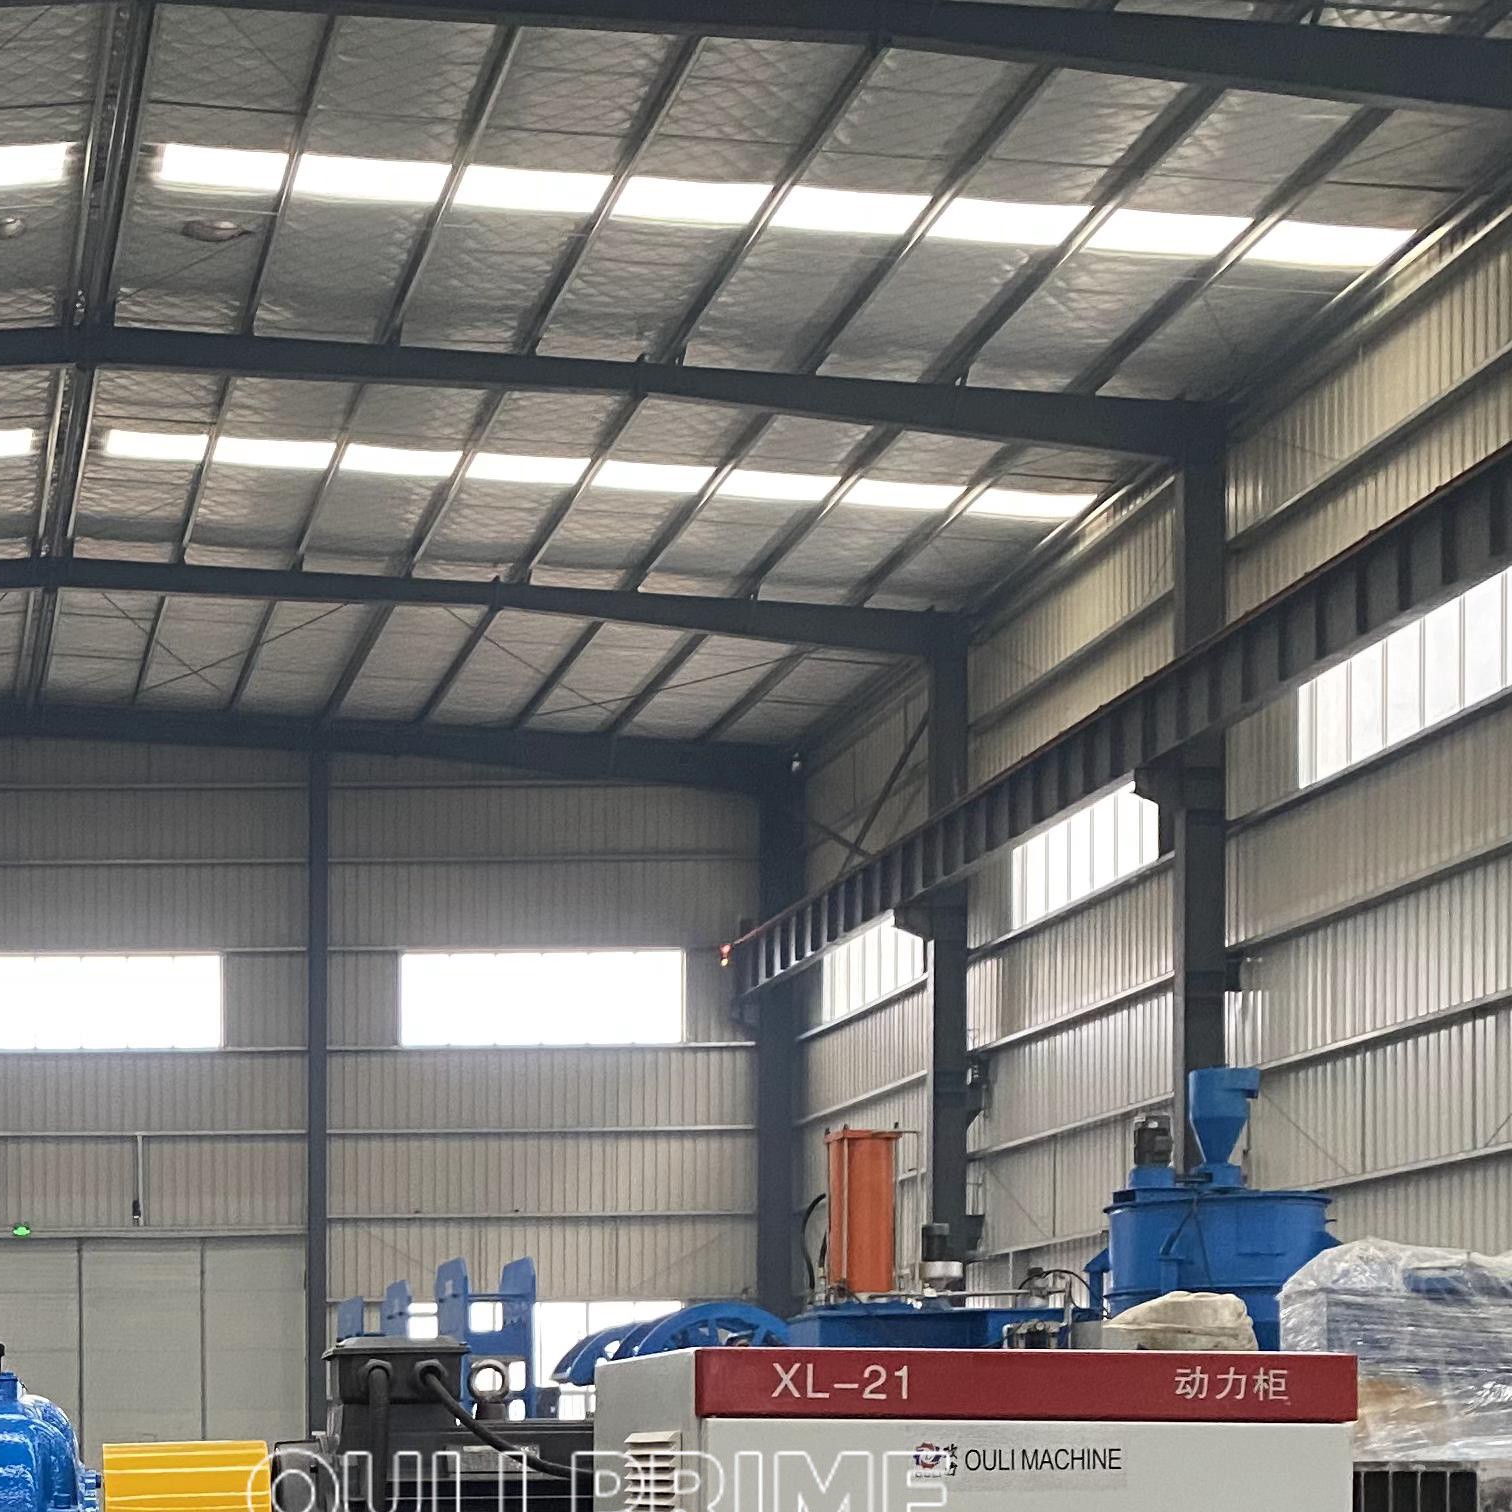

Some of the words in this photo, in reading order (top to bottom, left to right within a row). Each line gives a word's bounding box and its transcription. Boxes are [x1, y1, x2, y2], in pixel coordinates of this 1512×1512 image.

[771, 1362, 911, 1400] XL-21
[1174, 1366, 1290, 1401] 动力柜
[965, 1449, 1015, 1471] OULI
[1021, 1448, 1122, 1471] MACHINE
